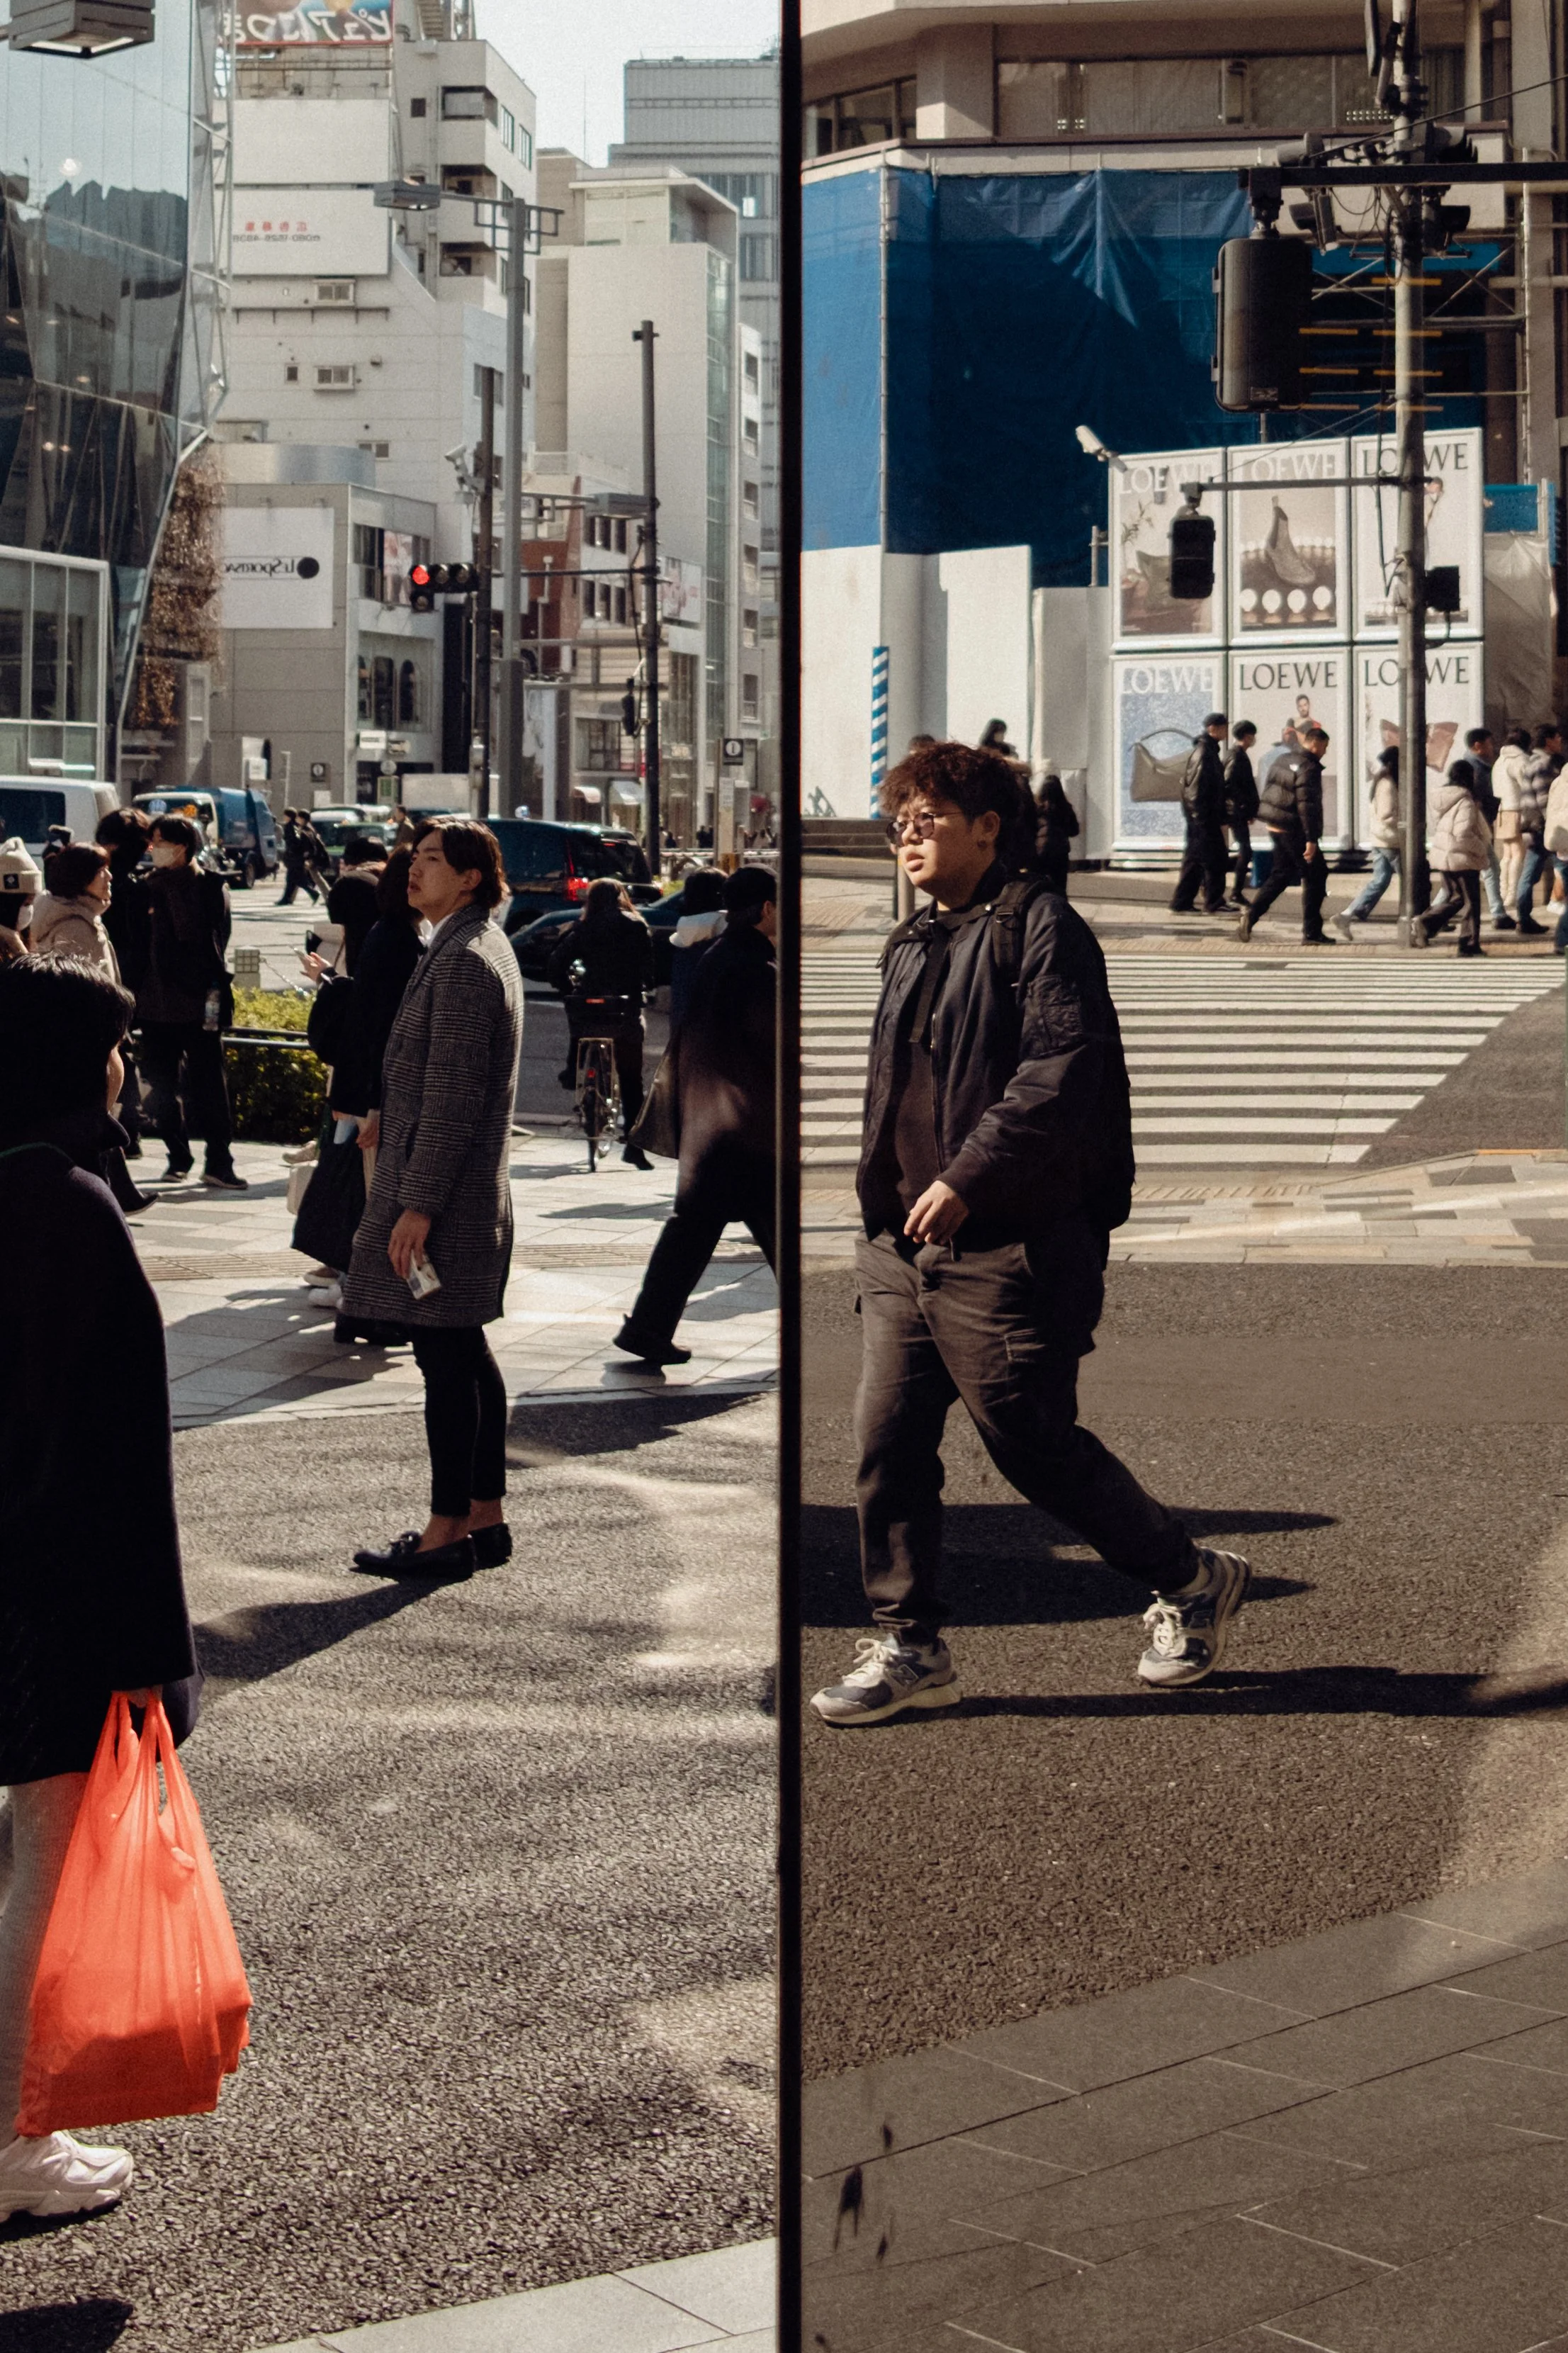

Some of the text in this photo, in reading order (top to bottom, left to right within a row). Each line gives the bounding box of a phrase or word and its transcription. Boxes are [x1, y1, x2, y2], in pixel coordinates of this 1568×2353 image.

[1363, 443, 1467, 476] LOWE
[1119, 464, 1213, 494] LOEWE
[1119, 666, 1213, 694] LOEWE
[1240, 661, 1338, 690] LOEWE
[1365, 656, 1469, 686] LOWE
